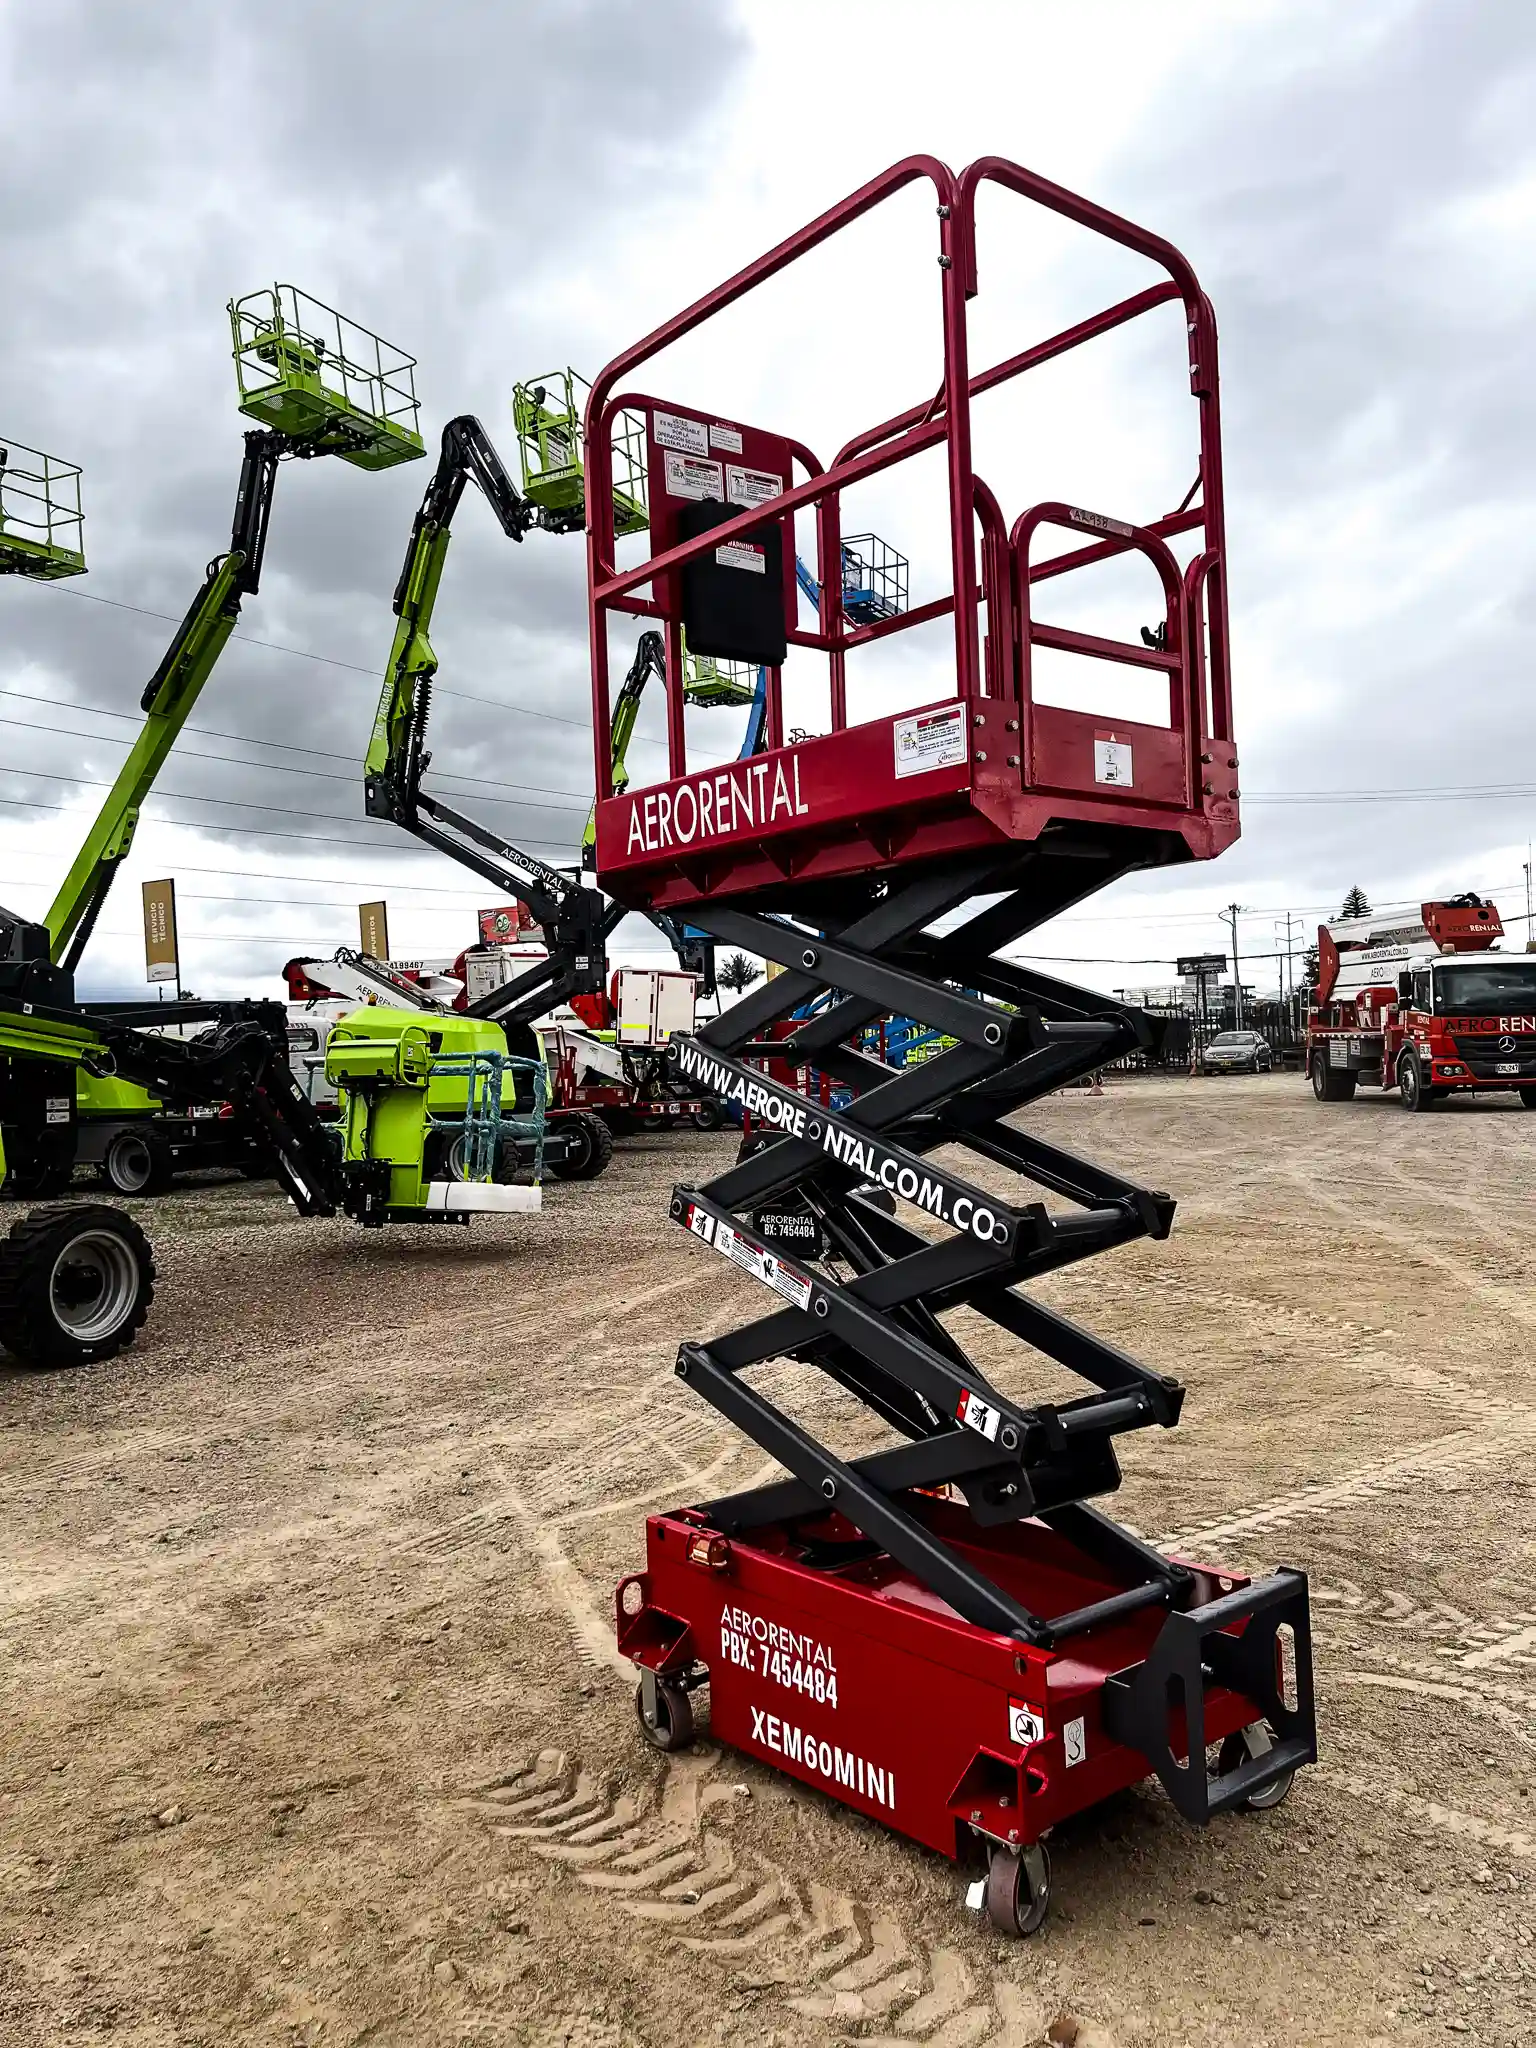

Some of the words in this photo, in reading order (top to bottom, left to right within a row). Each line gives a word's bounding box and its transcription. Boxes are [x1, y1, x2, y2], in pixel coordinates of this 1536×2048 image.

[667, 421, 700, 436] RESPONSABLE
[676, 441, 706, 454] PLATAFORMA
[627, 755, 809, 855] AERORENTAL
[500, 847, 563, 890] AERORENTAL
[150, 902, 159, 944] SERVICIO
[760, 1215, 815, 1226] AERORENTAL
[779, 1225, 815, 1238] 7454484
[720, 1604, 837, 1673] AERORENTAL
[721, 1627, 755, 1672] PBX:
[760, 1644, 838, 1710] 7454484
[750, 1705, 896, 1810] XEM60MINI
